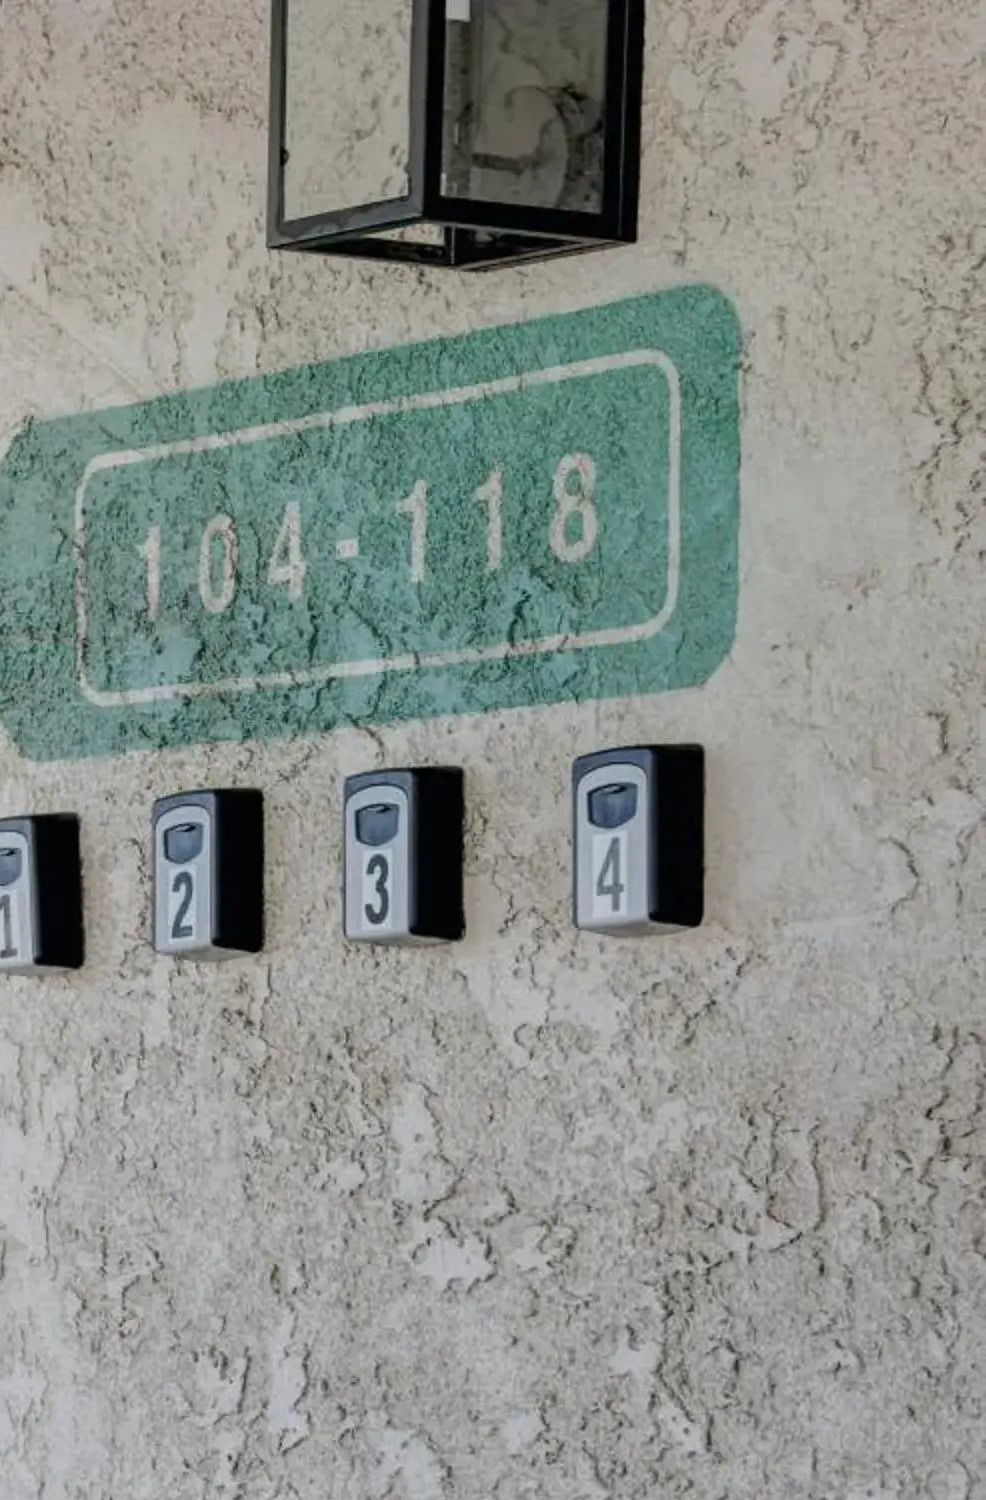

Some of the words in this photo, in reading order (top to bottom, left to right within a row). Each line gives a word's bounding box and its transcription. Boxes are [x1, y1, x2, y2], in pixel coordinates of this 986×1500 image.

[136, 452, 598, 620] 104-118
[171, 871, 194, 939] 2
[364, 854, 389, 925] 3
[596, 837, 625, 912] 4
